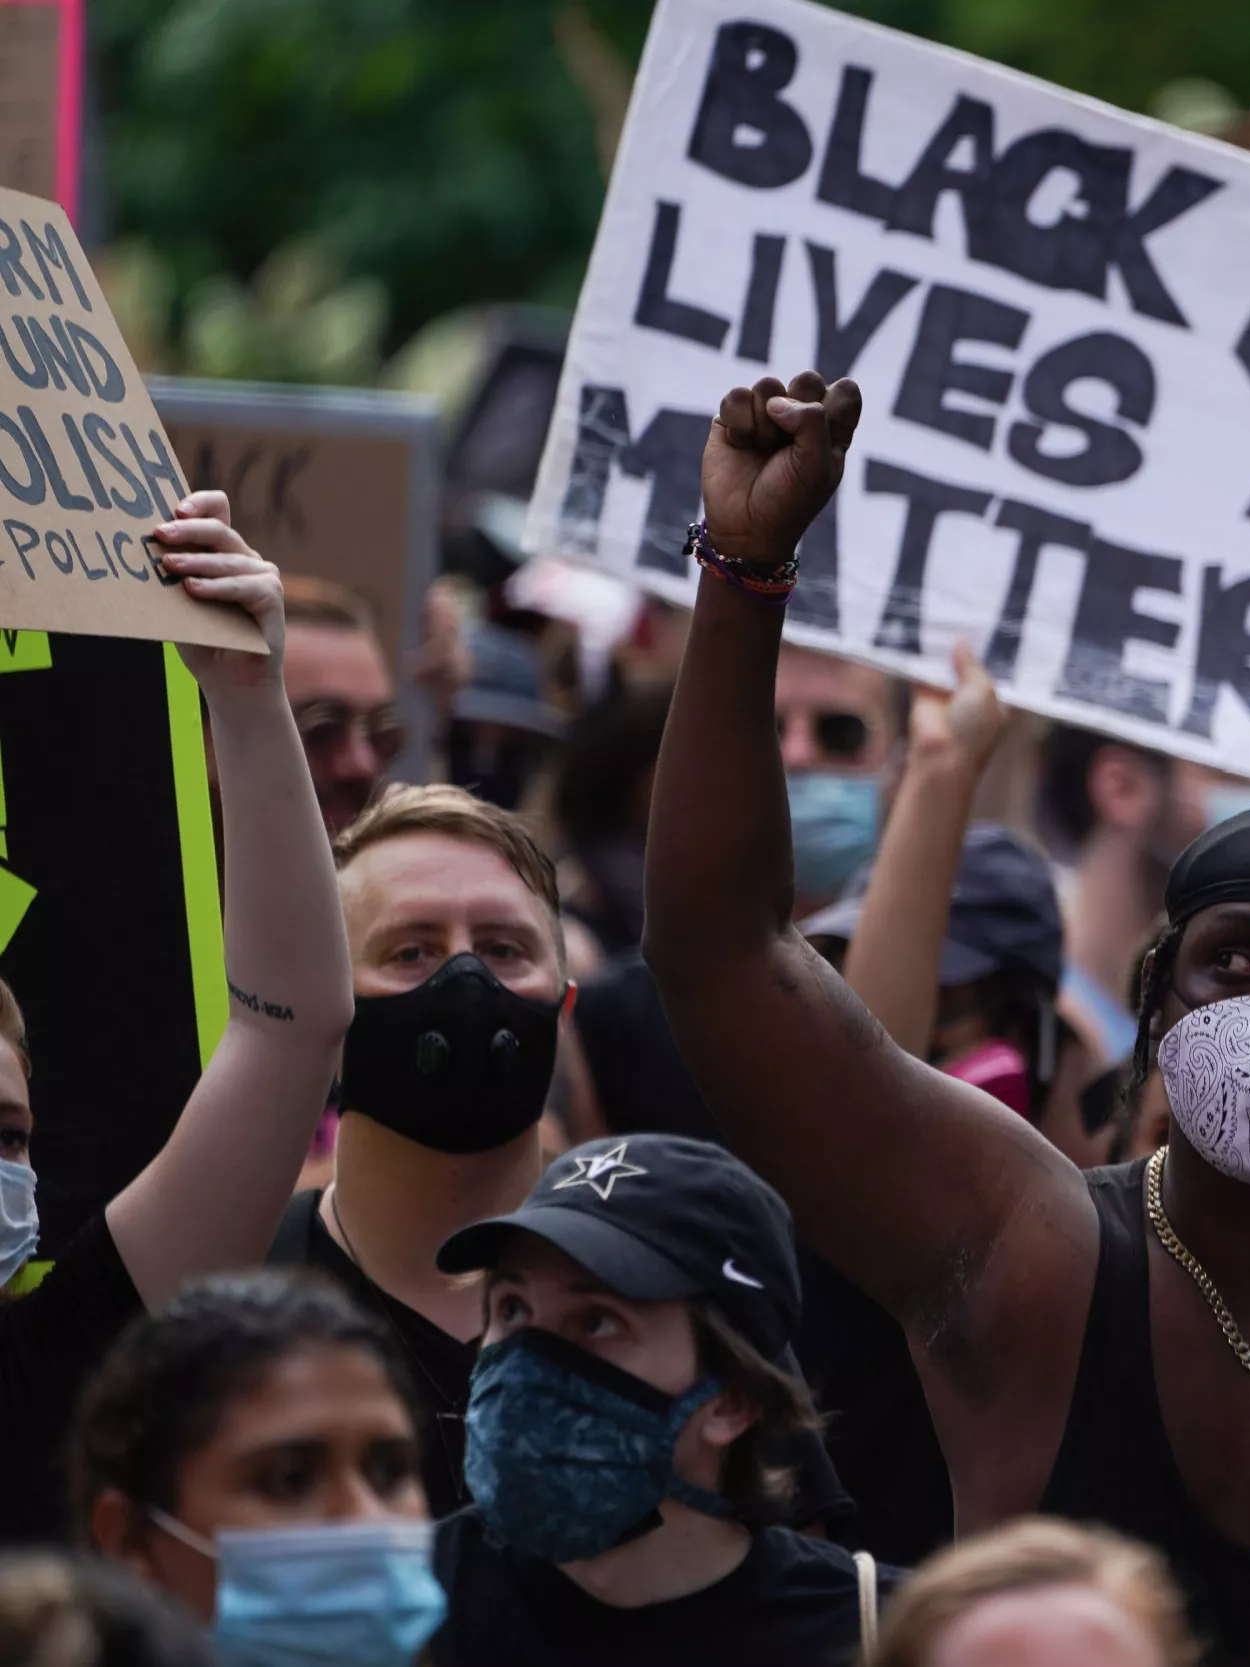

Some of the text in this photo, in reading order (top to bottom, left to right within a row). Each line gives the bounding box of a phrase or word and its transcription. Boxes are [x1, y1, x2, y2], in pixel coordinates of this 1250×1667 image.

[687, 20, 1226, 330] BLACK
[633, 200, 1157, 488] LIVES
[3, 519, 183, 586] POLICE
